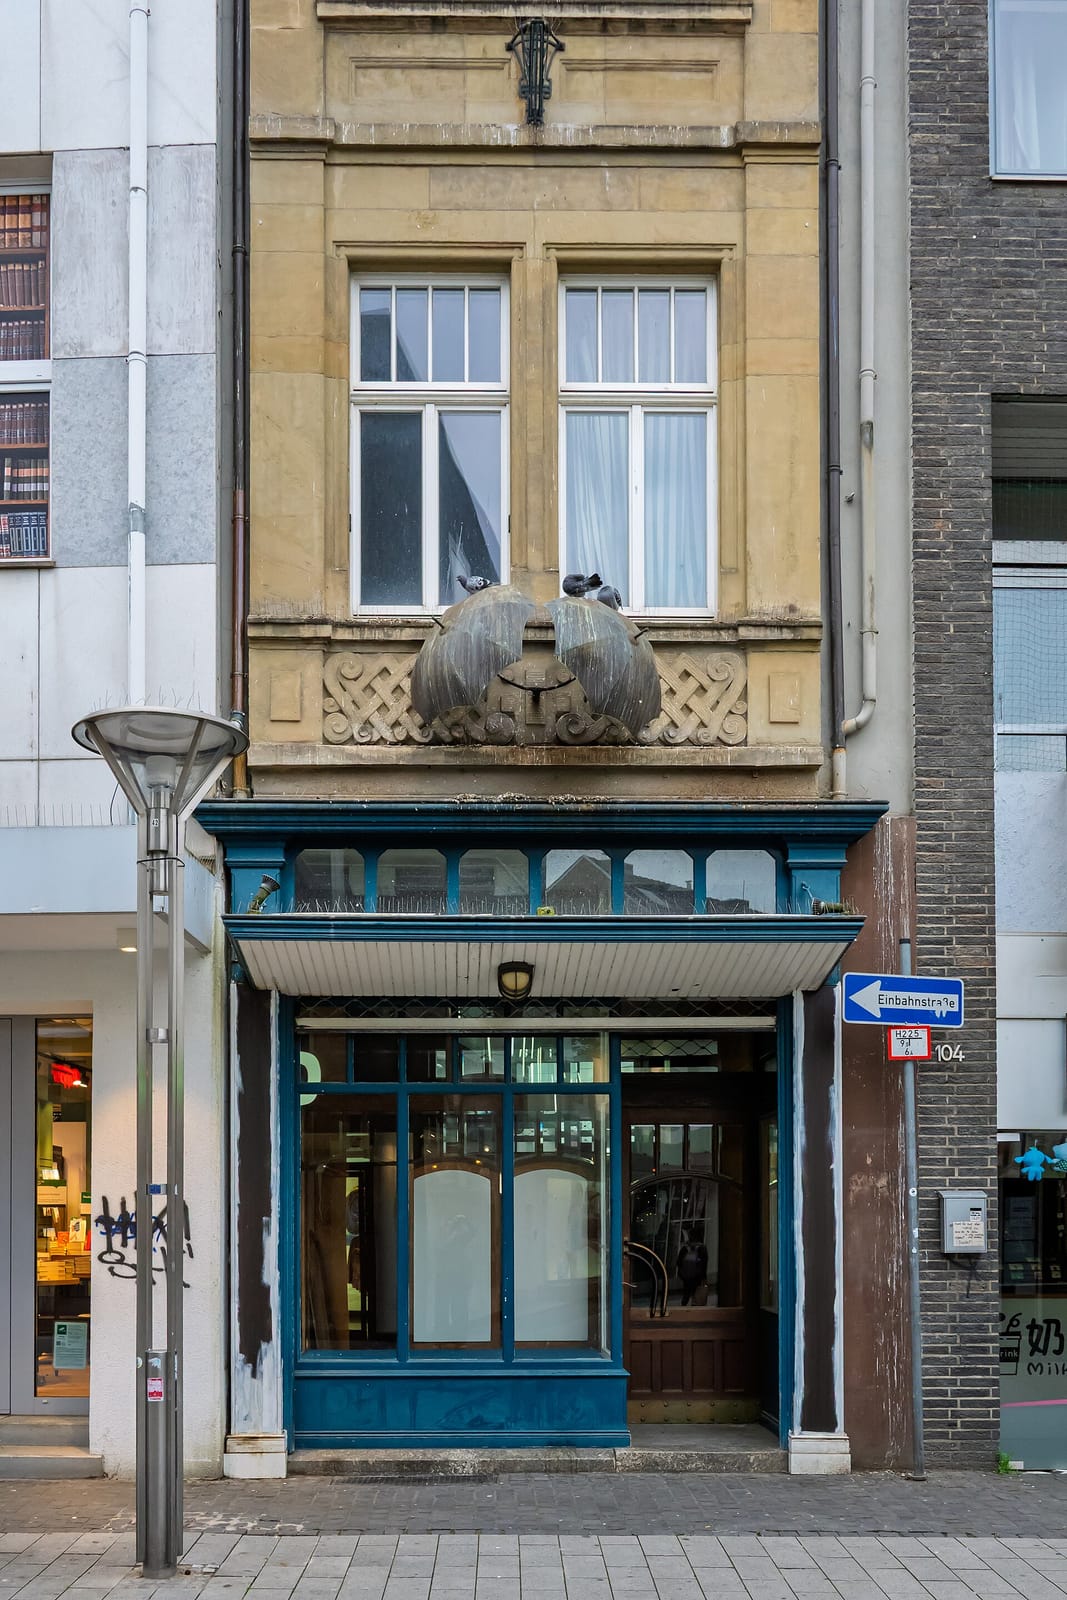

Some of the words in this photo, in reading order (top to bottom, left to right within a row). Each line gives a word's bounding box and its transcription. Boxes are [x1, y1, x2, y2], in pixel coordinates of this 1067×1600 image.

[878, 994, 955, 1009] Einbahnstraße
[895, 1030, 920, 1038] H225
[935, 1044, 965, 1062] 104
[1000, 1350, 1018, 1358] rink
